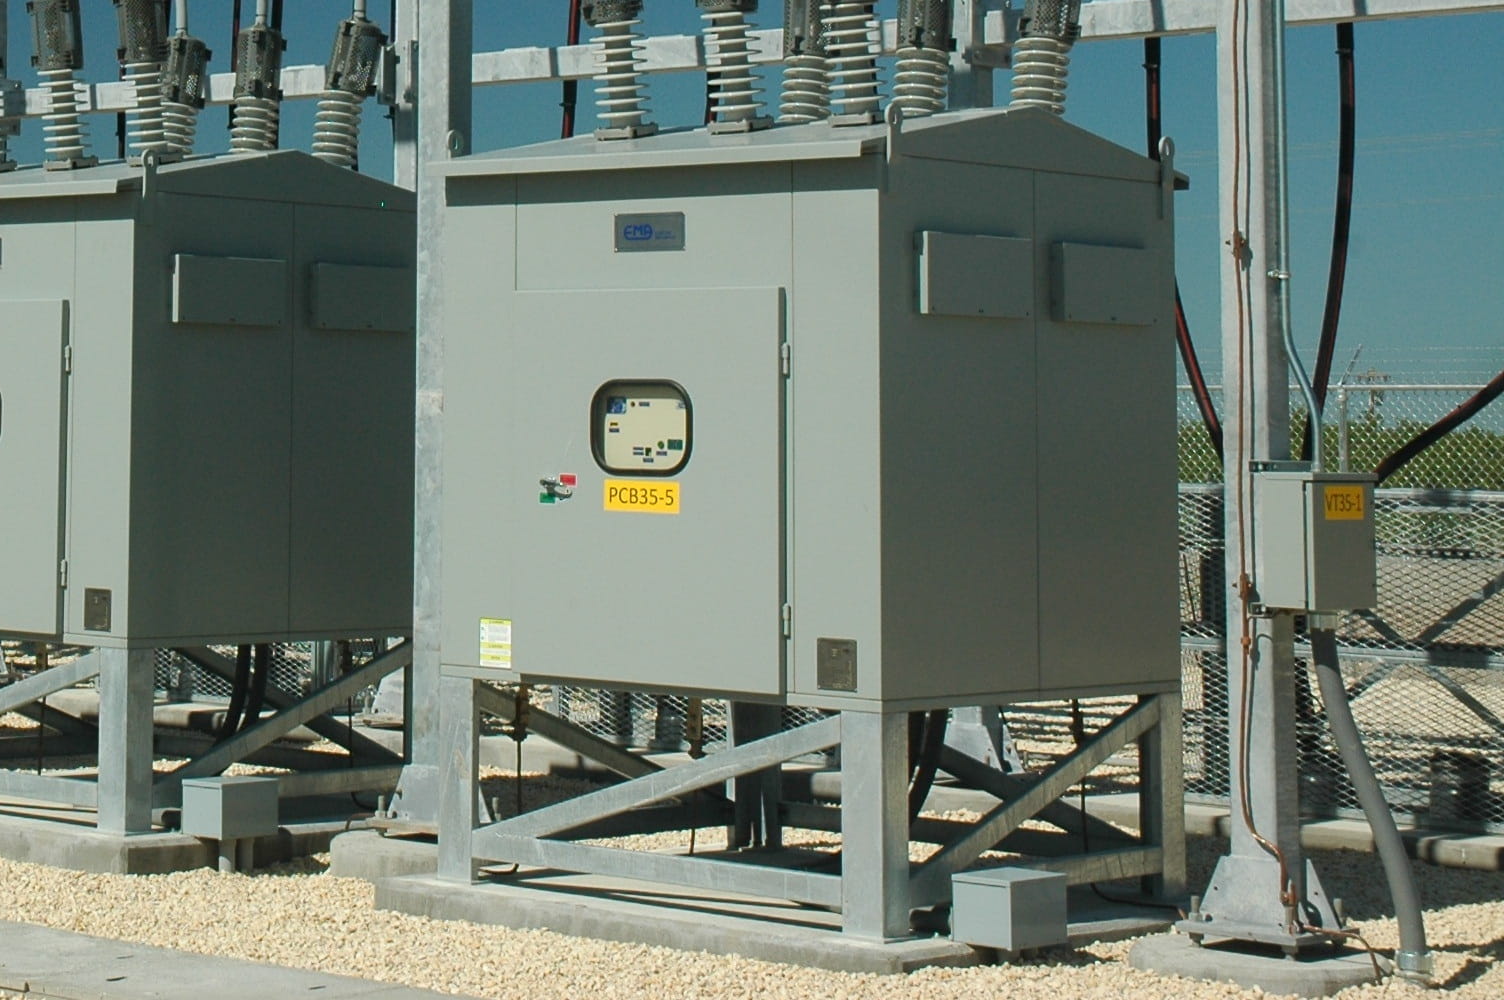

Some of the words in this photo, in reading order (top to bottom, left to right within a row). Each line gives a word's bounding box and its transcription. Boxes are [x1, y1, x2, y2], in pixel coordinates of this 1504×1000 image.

[623, 223, 653, 241] EMA
[609, 487, 674, 506] PCB35-5
[1325, 494, 1361, 513] VT35-1
